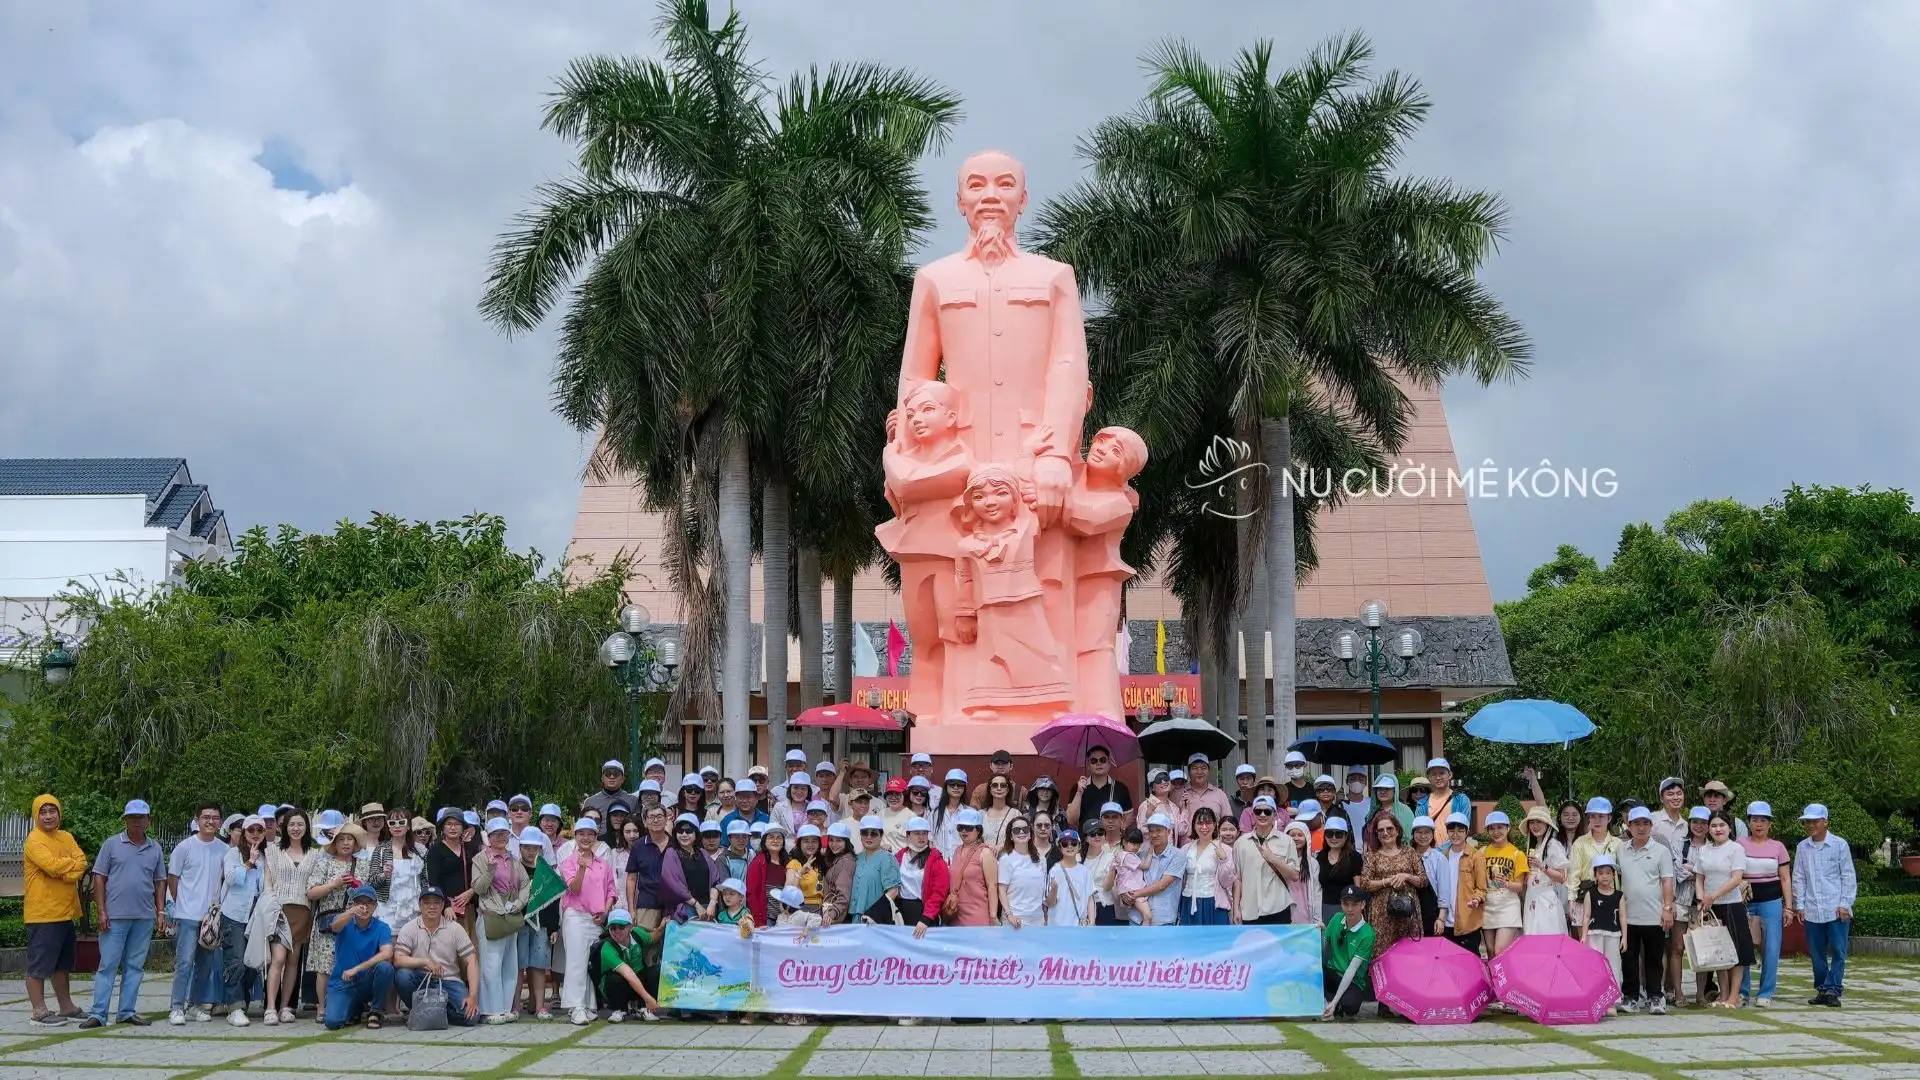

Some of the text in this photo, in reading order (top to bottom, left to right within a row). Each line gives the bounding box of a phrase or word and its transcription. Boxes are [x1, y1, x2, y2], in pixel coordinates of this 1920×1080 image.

[1123, 681, 1142, 708] CỦA
[1485, 856, 1514, 870] TUDIO
[778, 958, 846, 993] Cùng
[847, 957, 880, 986] đi
[880, 956, 954, 986] Phan
[1037, 956, 1106, 987] Mình
[1107, 959, 1147, 987] vui
[1147, 957, 1189, 988] hết
